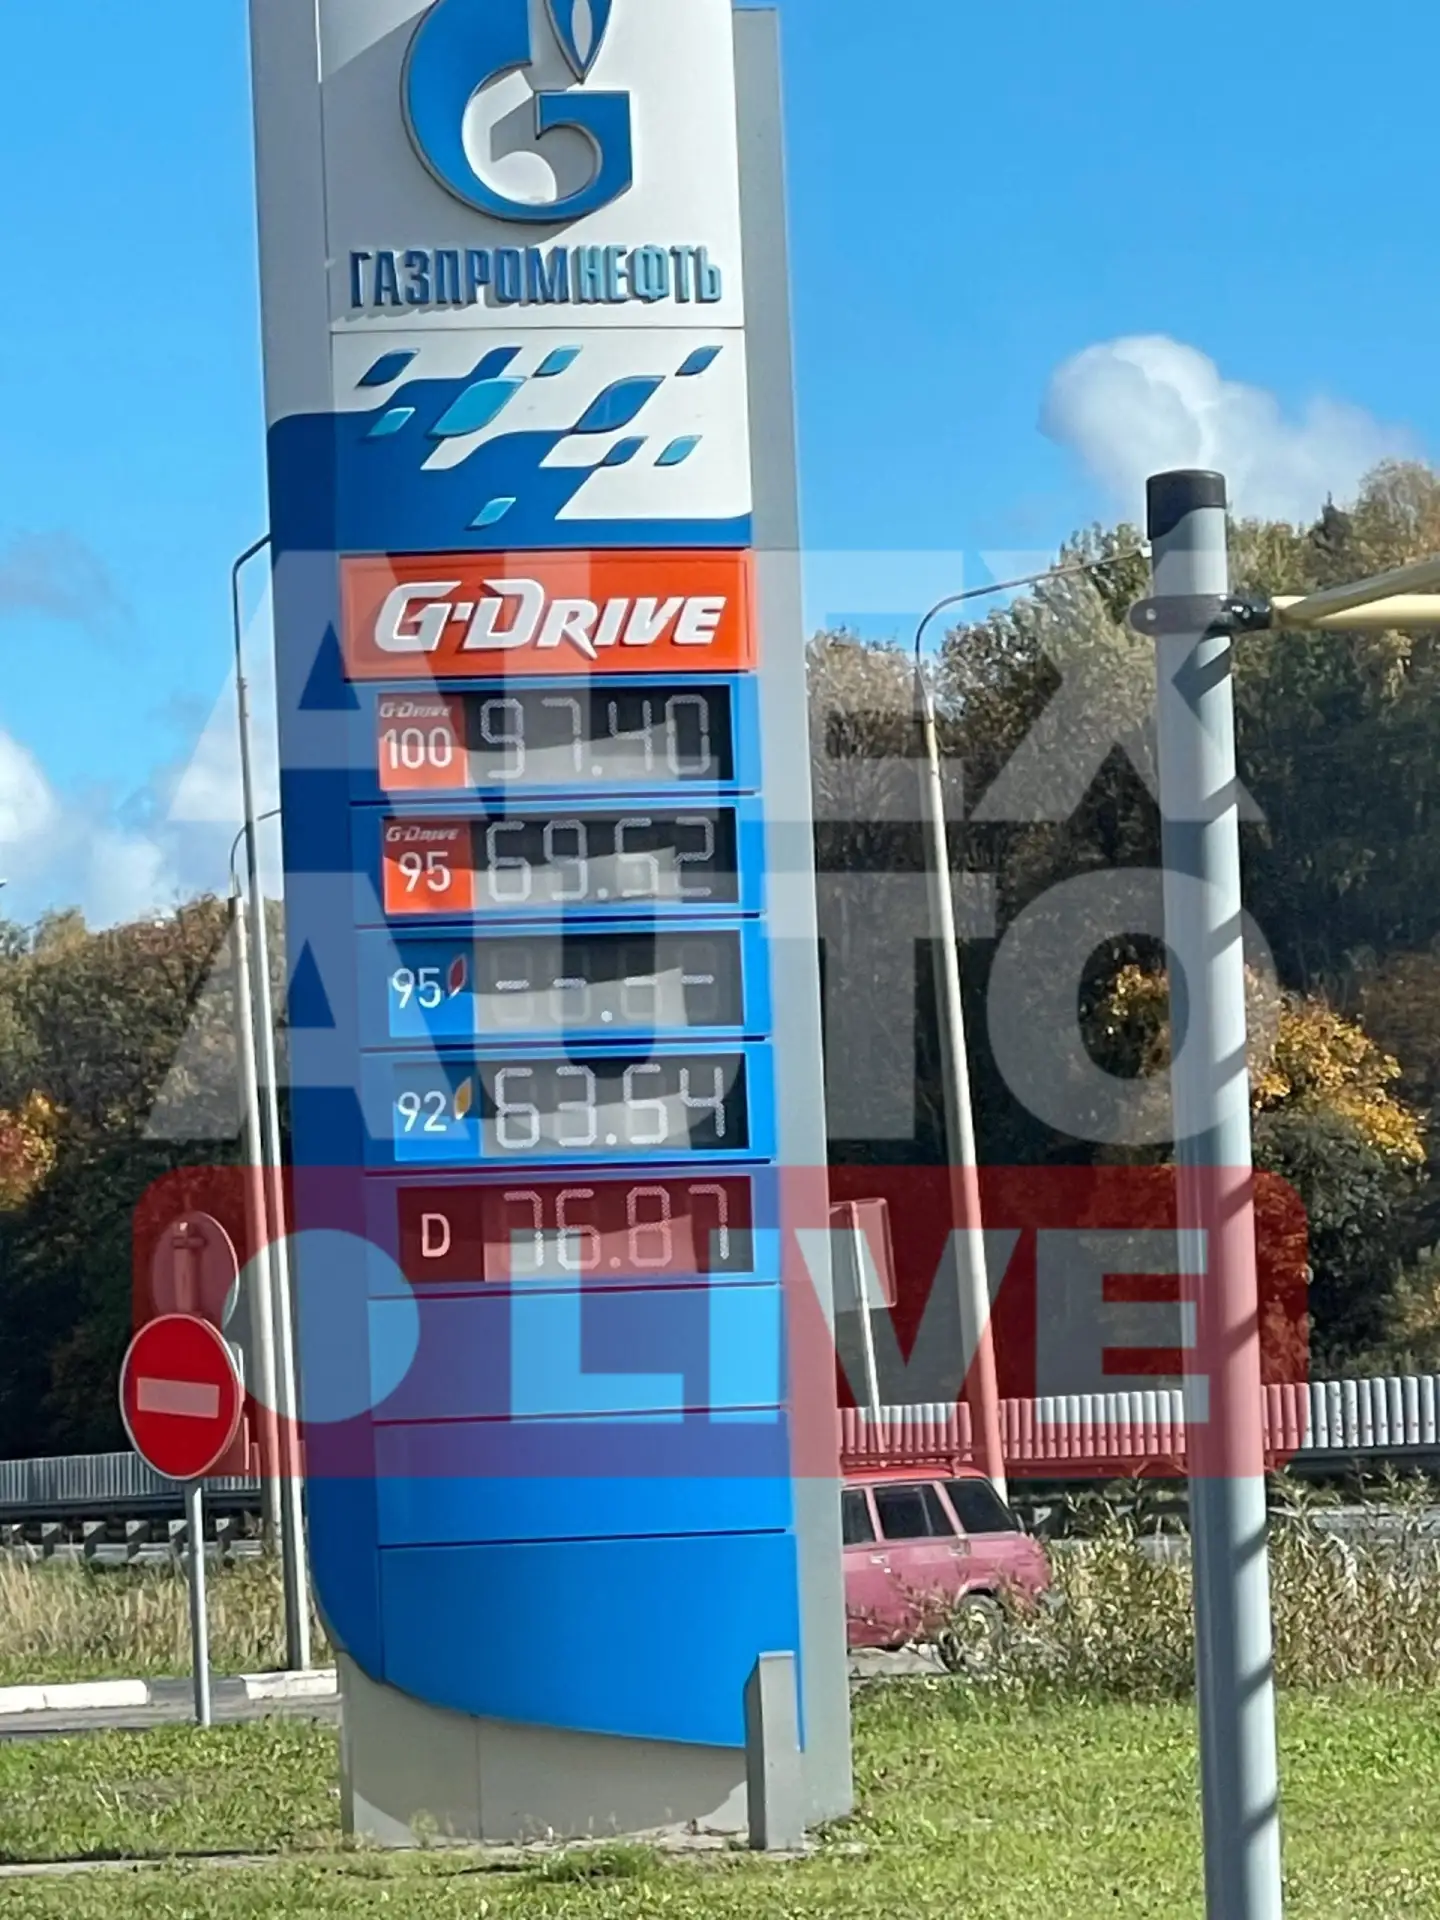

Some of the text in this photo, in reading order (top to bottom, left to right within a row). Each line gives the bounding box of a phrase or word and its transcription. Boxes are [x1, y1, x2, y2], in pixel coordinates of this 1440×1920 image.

[349, 246, 722, 308] ГАЗПРОМНЕФТЬ
[383, 727, 452, 770] 100
[480, 695, 710, 779] 97.40
[399, 851, 451, 893] 95
[391, 967, 441, 1009] 95
[398, 1090, 447, 1136] 92
[421, 1213, 451, 1257] D
[503, 1184, 730, 1270] 76.87
